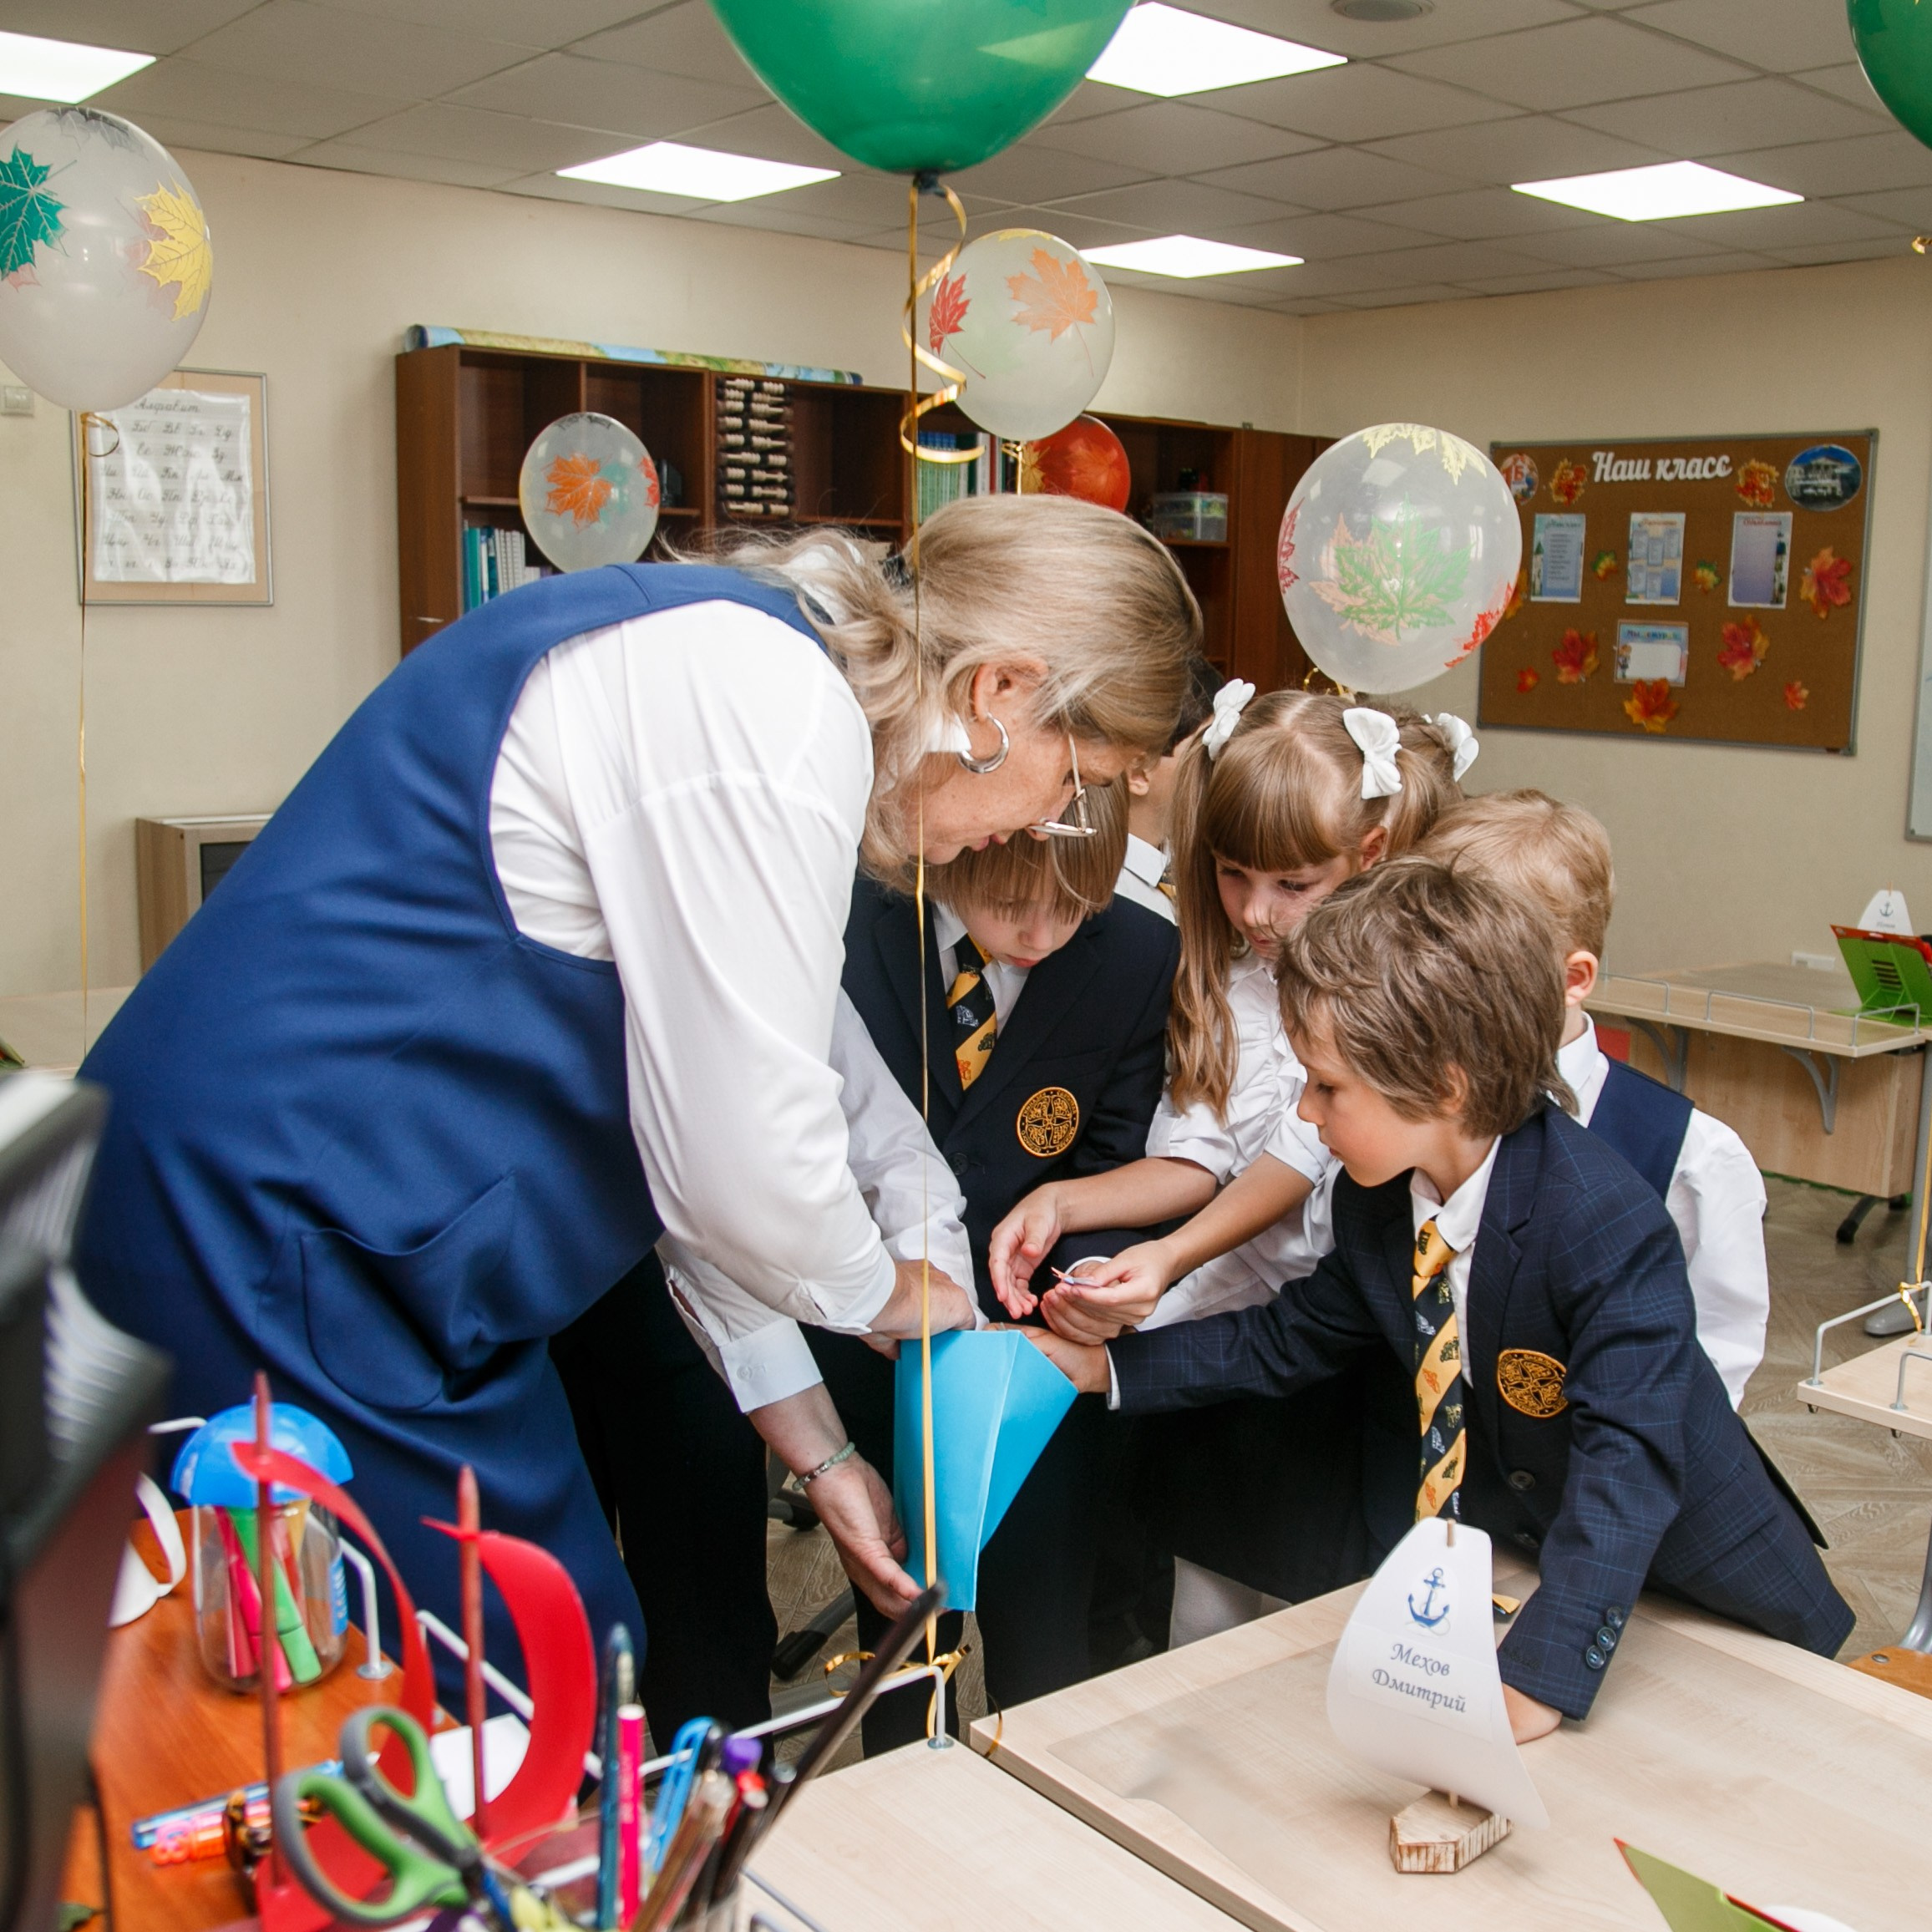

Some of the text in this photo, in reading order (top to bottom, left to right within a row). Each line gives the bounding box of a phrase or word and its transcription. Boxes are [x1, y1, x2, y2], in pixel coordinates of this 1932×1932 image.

[1592, 451, 1733, 483] Наш класс
[1391, 1643, 1450, 1676] Мехов
[1372, 1669, 1467, 1713] Дмитрий
